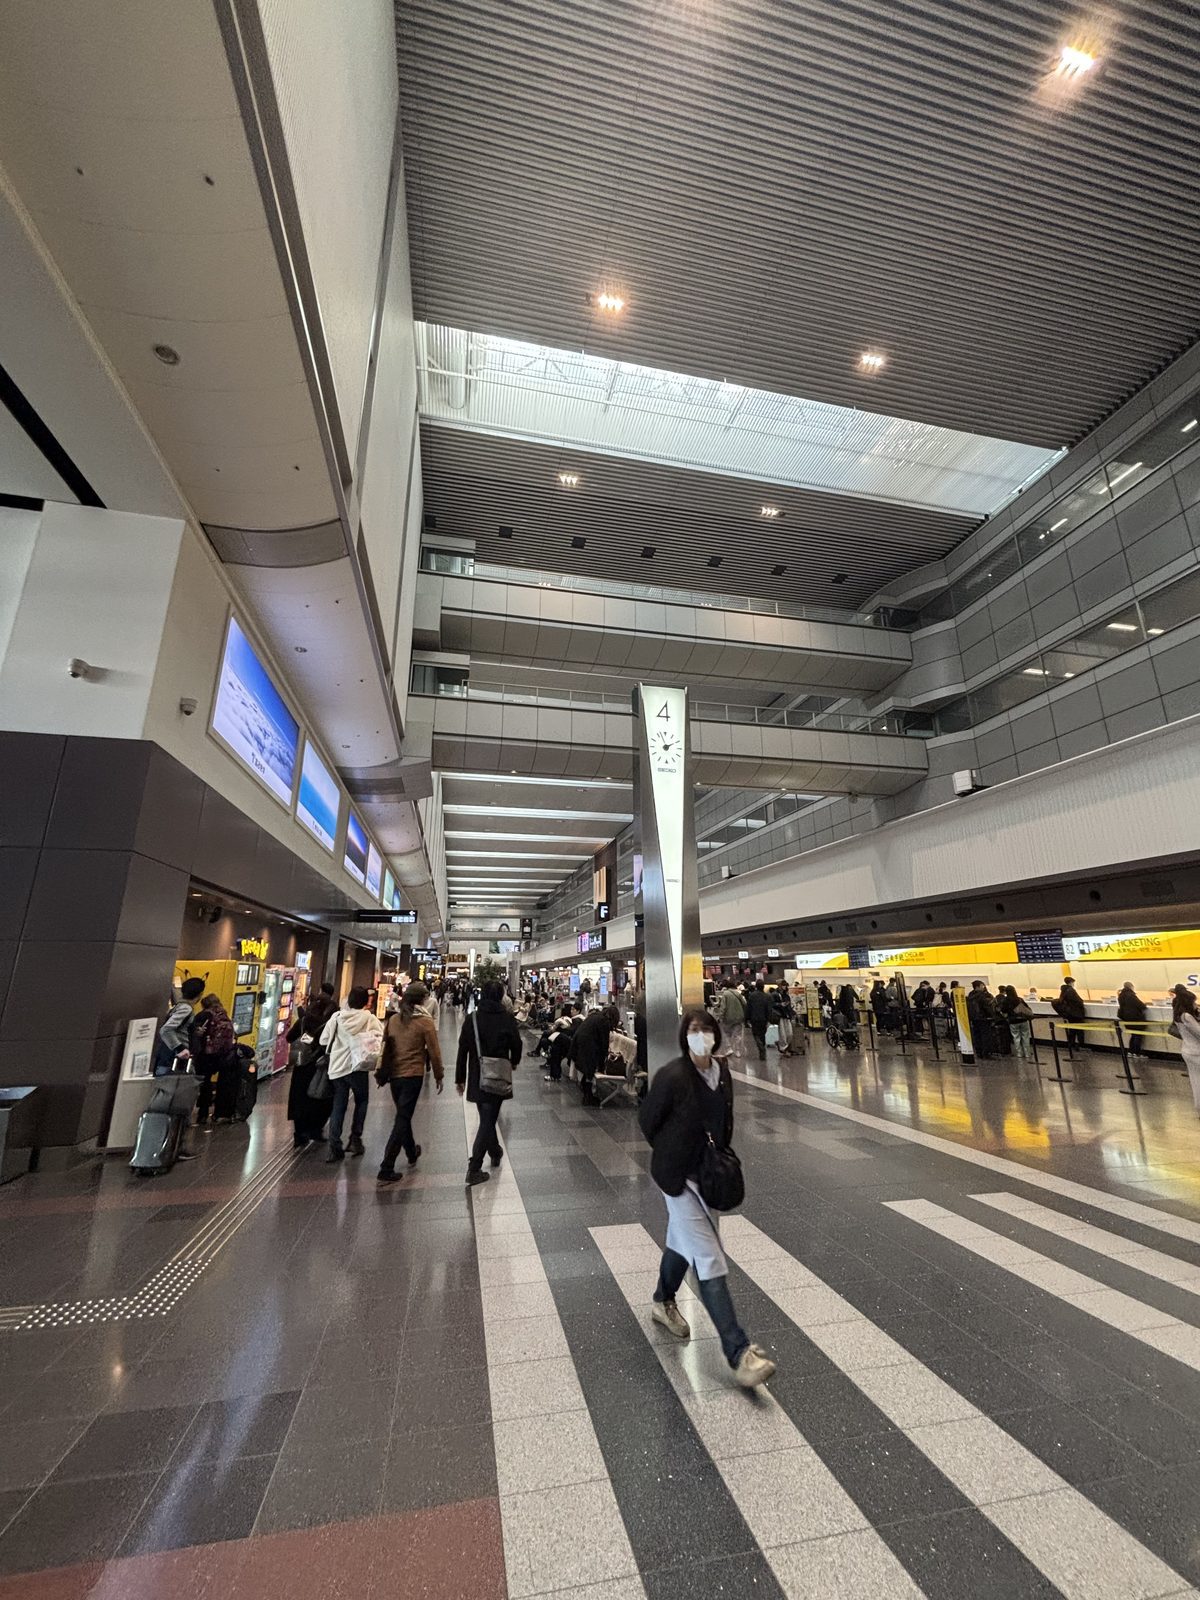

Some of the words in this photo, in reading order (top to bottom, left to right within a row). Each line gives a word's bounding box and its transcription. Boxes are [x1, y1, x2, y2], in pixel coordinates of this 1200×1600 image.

[656, 700, 671, 722] 4
[600, 905, 608, 918] F
[1116, 937, 1160, 947] TICKETING
